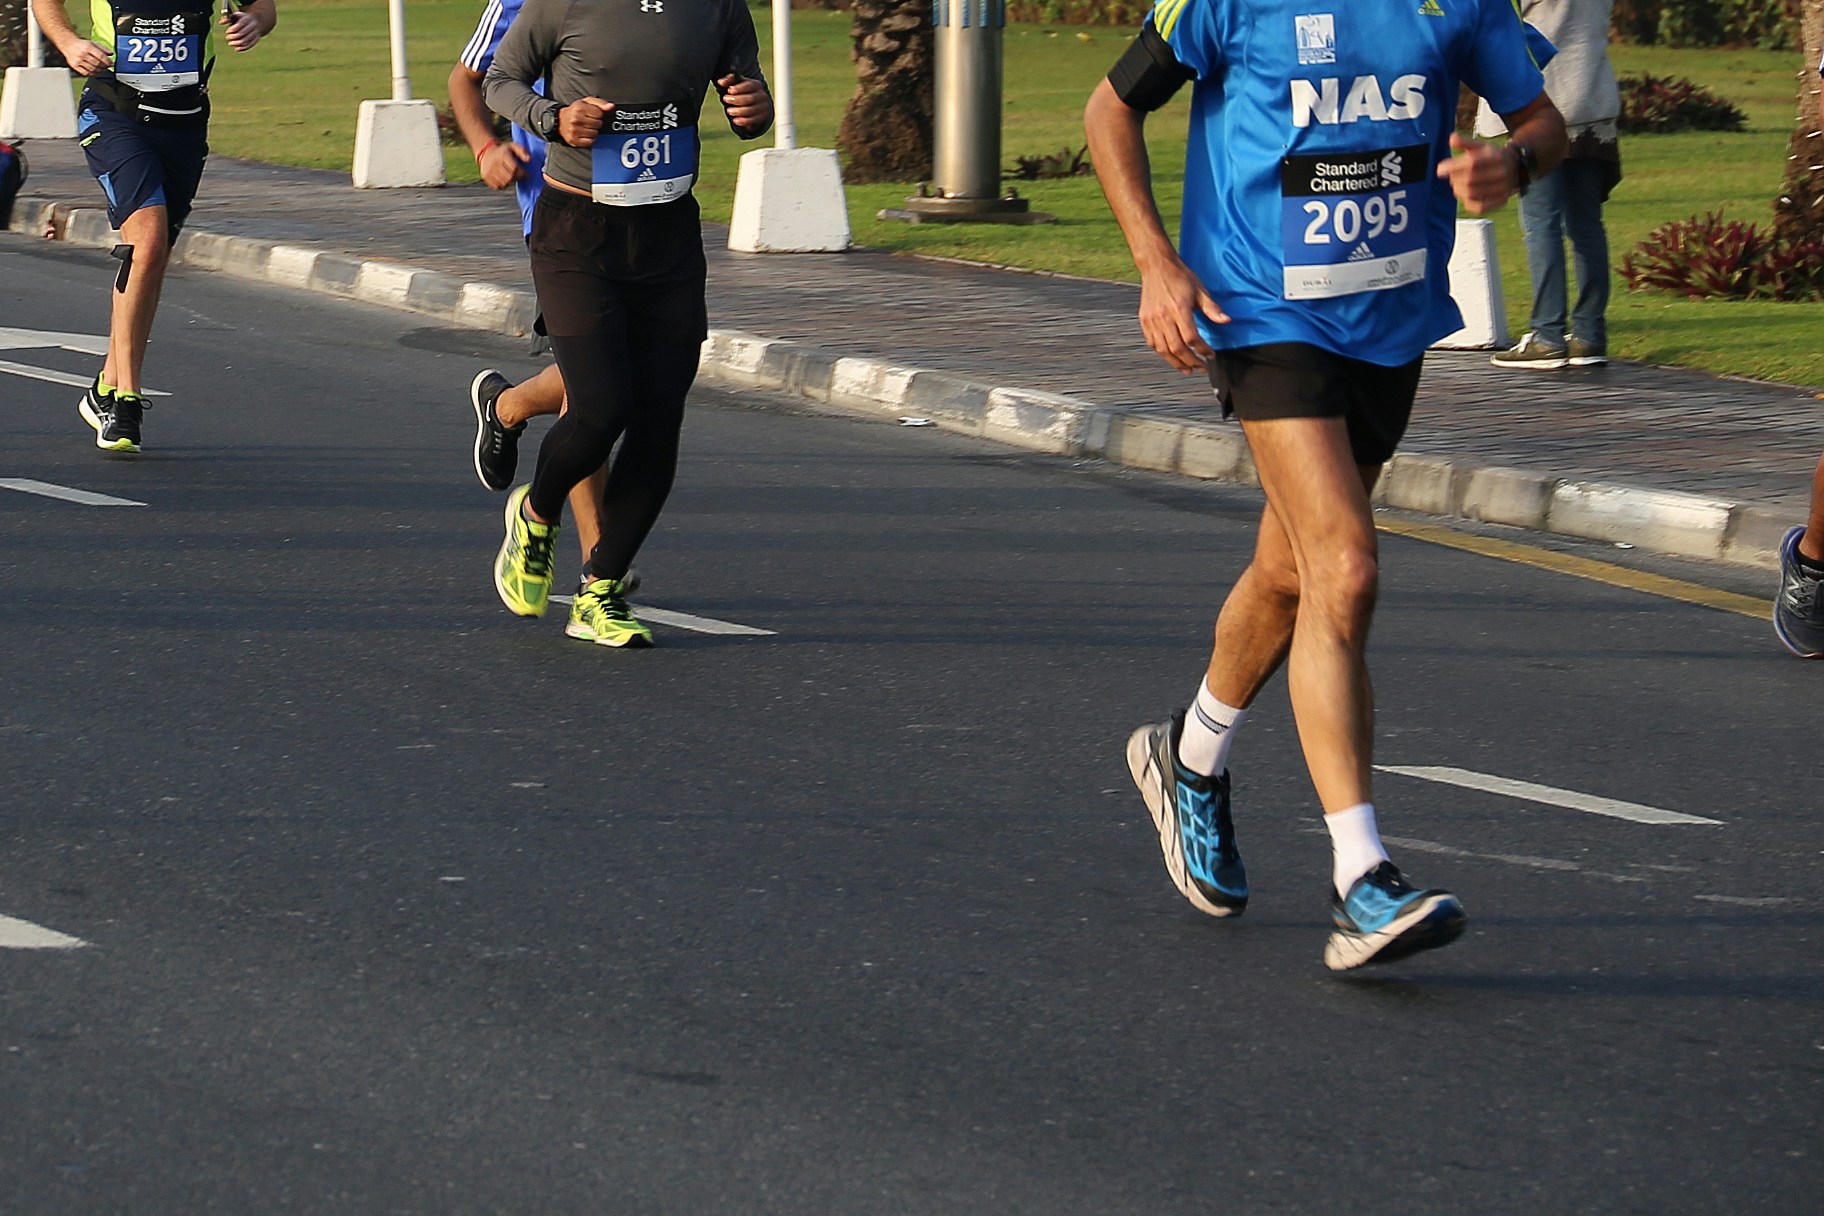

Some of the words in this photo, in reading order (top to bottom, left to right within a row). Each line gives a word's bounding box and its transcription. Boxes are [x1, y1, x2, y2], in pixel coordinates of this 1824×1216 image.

[131, 26, 170, 34] Chartered
[134, 17, 170, 26] Standard
[127, 37, 188, 62] 2256
[1290, 74, 1427, 127] NAS
[615, 109, 661, 120] Standard
[611, 120, 661, 131] Chartered
[620, 134, 671, 169] 681
[1315, 159, 1378, 177] Standard
[1310, 174, 1378, 193] Chartered
[1302, 189, 1409, 245] 2095
